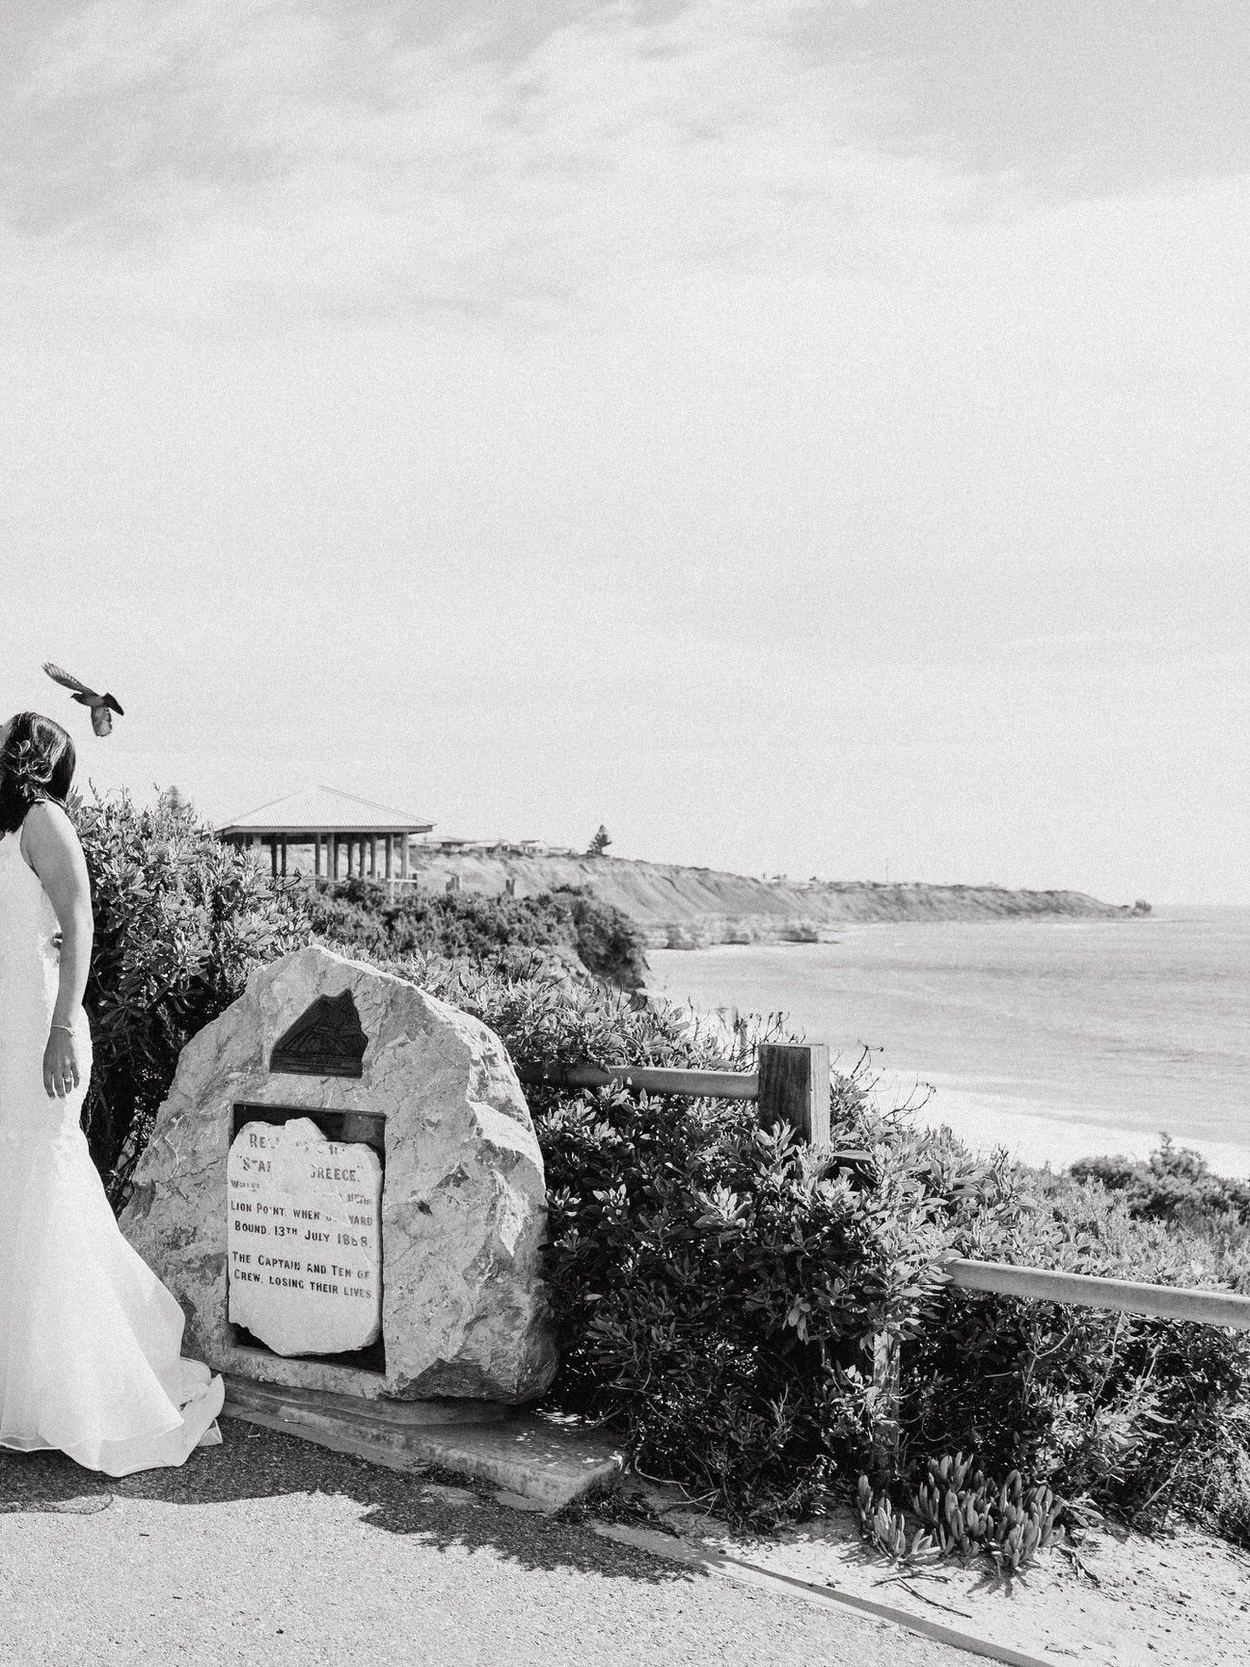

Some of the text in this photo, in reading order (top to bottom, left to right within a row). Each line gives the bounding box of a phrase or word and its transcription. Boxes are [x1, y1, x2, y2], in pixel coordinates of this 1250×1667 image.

[230, 1200, 252, 1213] LION
[293, 1209, 320, 1220] WHEN
[274, 1225, 298, 1237] 13TH
[304, 1229, 330, 1243] JULY
[232, 1250, 370, 1280] THE CAPTAIN AND TEN OF
[269, 1275, 305, 1290] LOSING
[309, 1281, 339, 1295] THEIR
